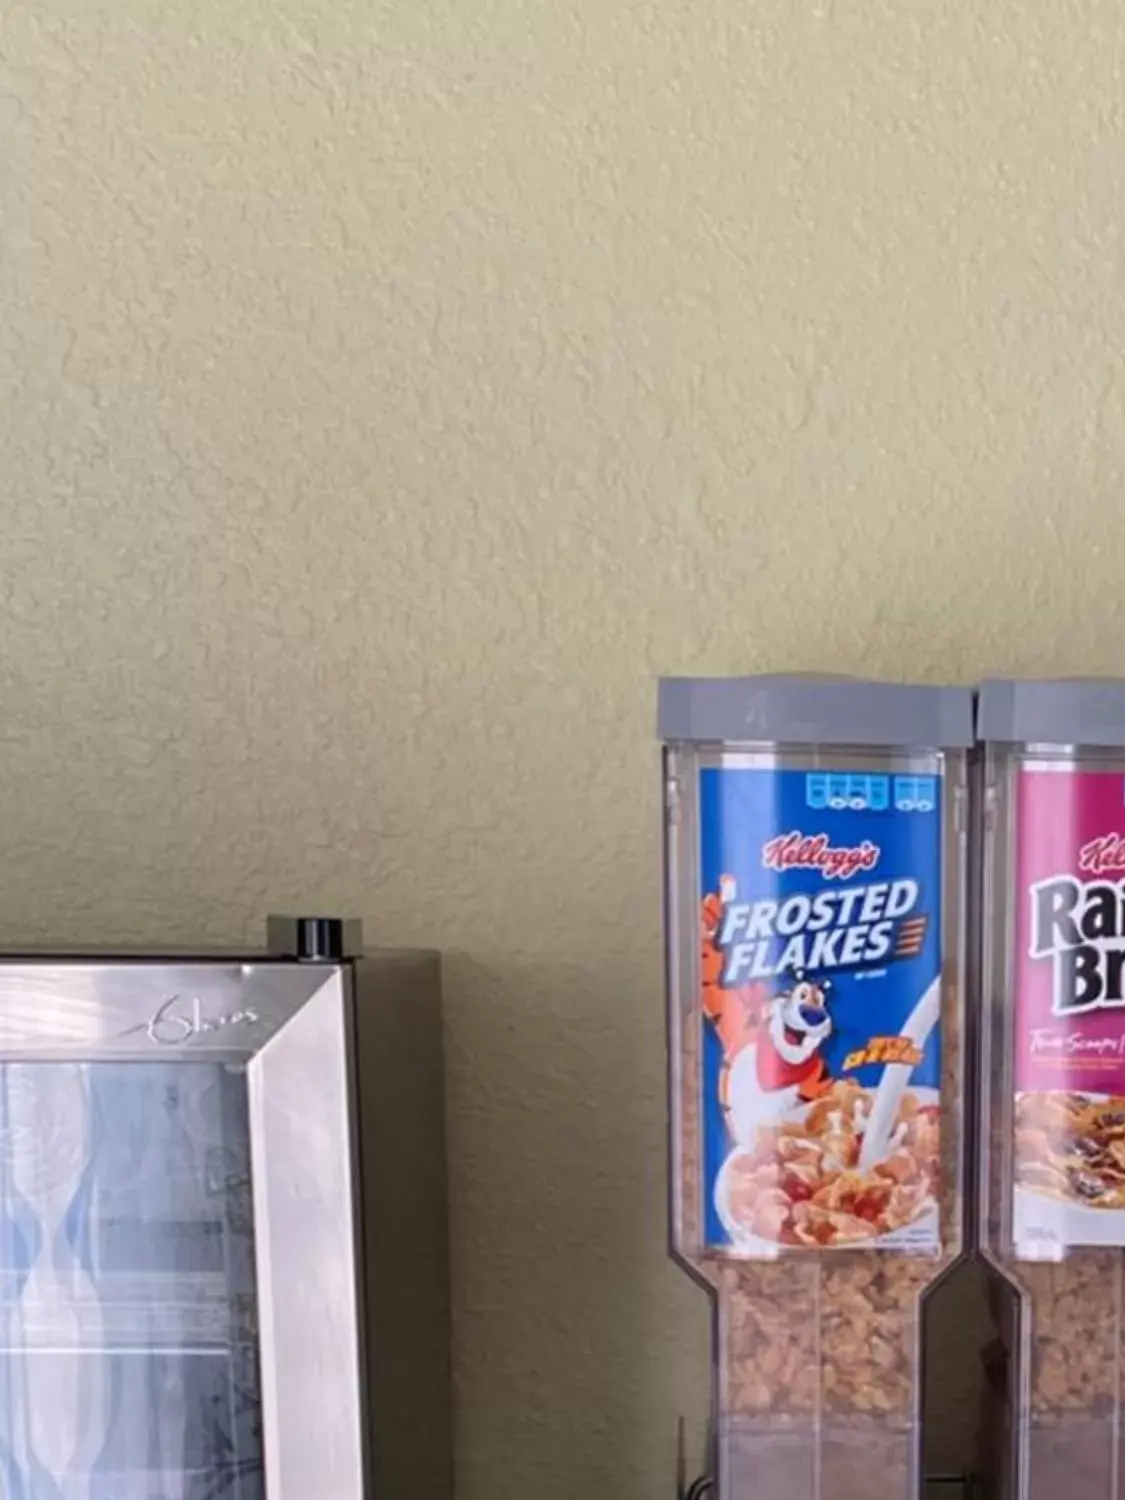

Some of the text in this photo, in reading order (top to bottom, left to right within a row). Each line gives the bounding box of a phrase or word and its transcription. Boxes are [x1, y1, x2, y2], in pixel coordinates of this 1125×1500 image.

[764, 832, 880, 879] Kellogg's
[721, 880, 918, 944] FROSTED
[725, 921, 893, 982] FLAKES
